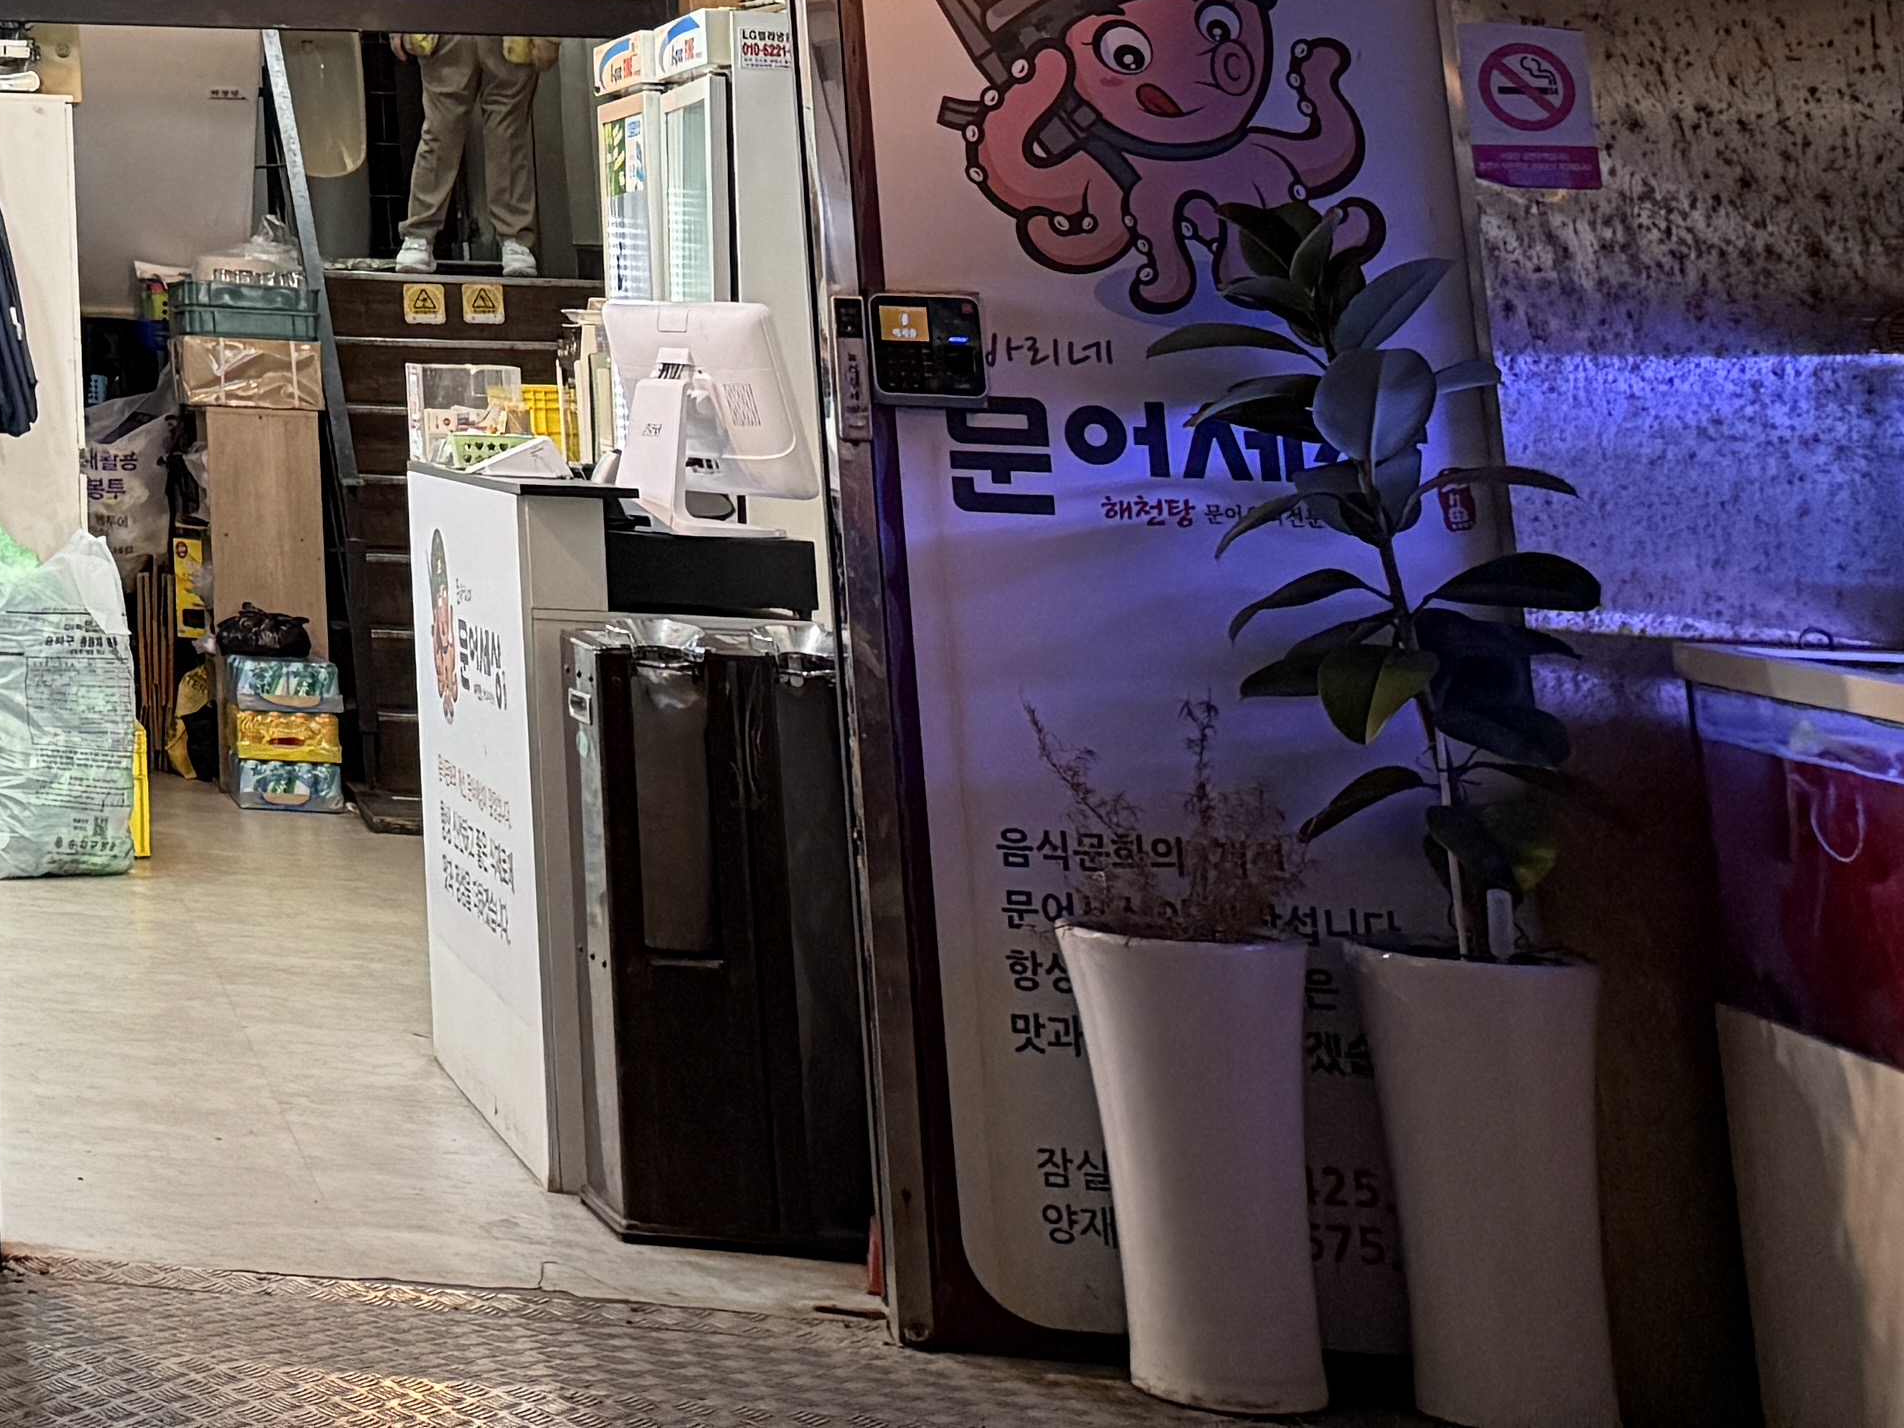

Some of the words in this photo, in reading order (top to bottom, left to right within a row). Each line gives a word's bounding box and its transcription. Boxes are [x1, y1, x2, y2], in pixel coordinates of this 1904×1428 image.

[946, 395, 1428, 517] 문어세
[87, 477, 126, 501] 봉투
[1100, 494, 1196, 527] 해천탕
[457, 617, 508, 711] 문어세상
[995, 826, 1186, 877] 음식문화의
[1009, 1012, 1085, 1058] 맛과
